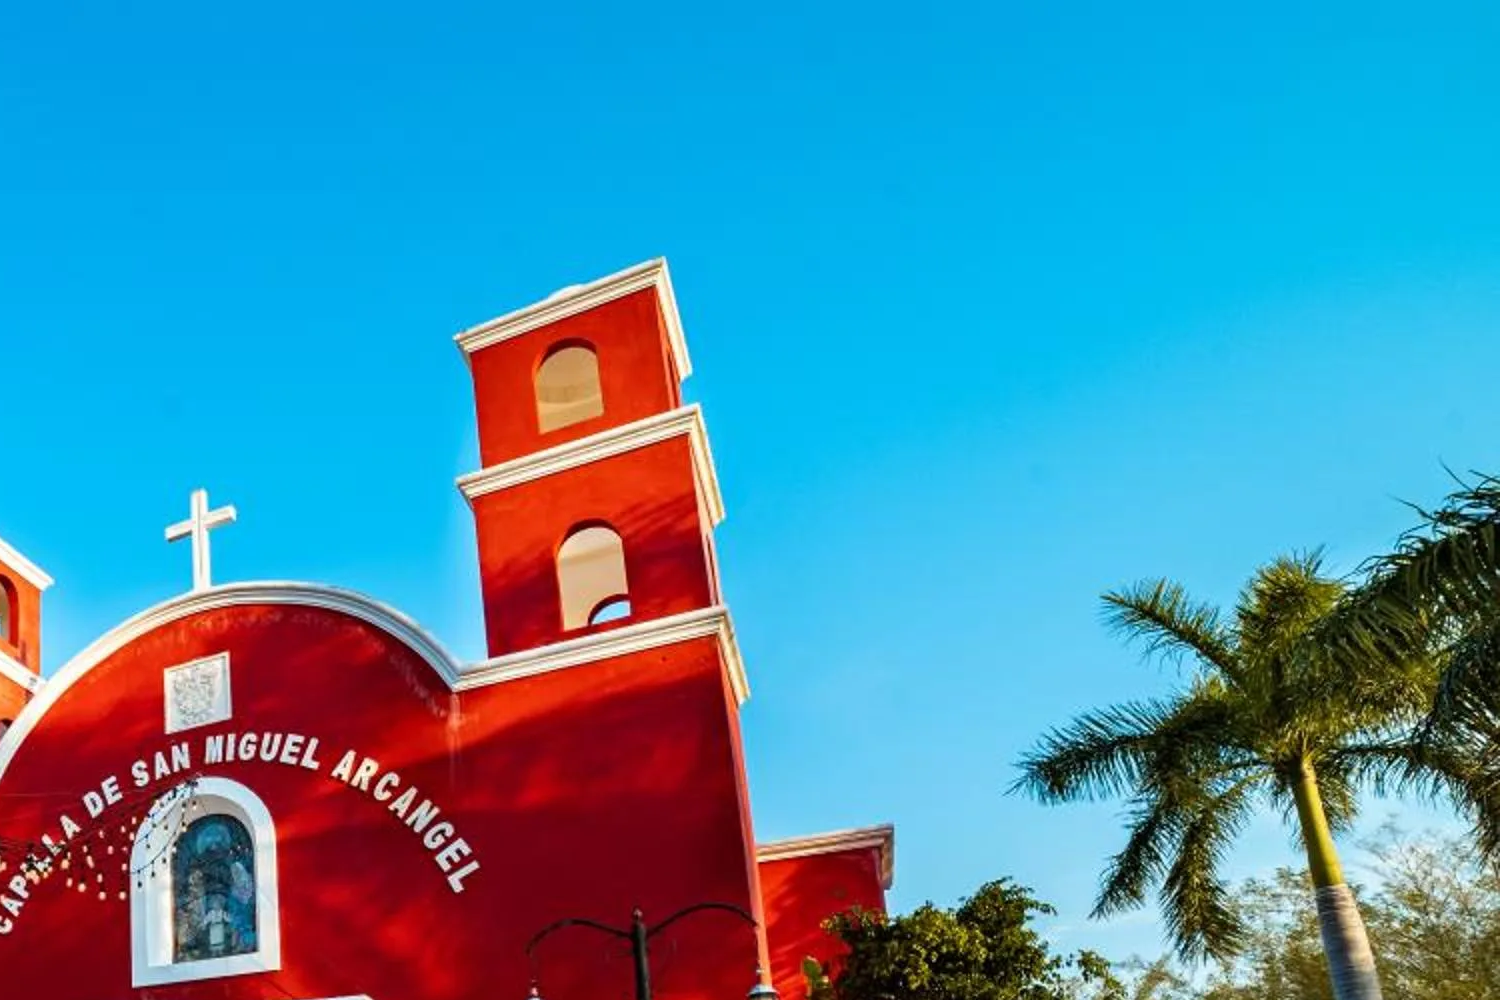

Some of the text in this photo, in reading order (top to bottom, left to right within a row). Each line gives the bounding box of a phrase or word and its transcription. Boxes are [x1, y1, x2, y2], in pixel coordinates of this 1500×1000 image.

[83, 776, 123, 818] DE
[131, 742, 191, 787] SAN
[204, 732, 320, 770] MIGUEL
[331, 750, 480, 893] ARCANGEL
